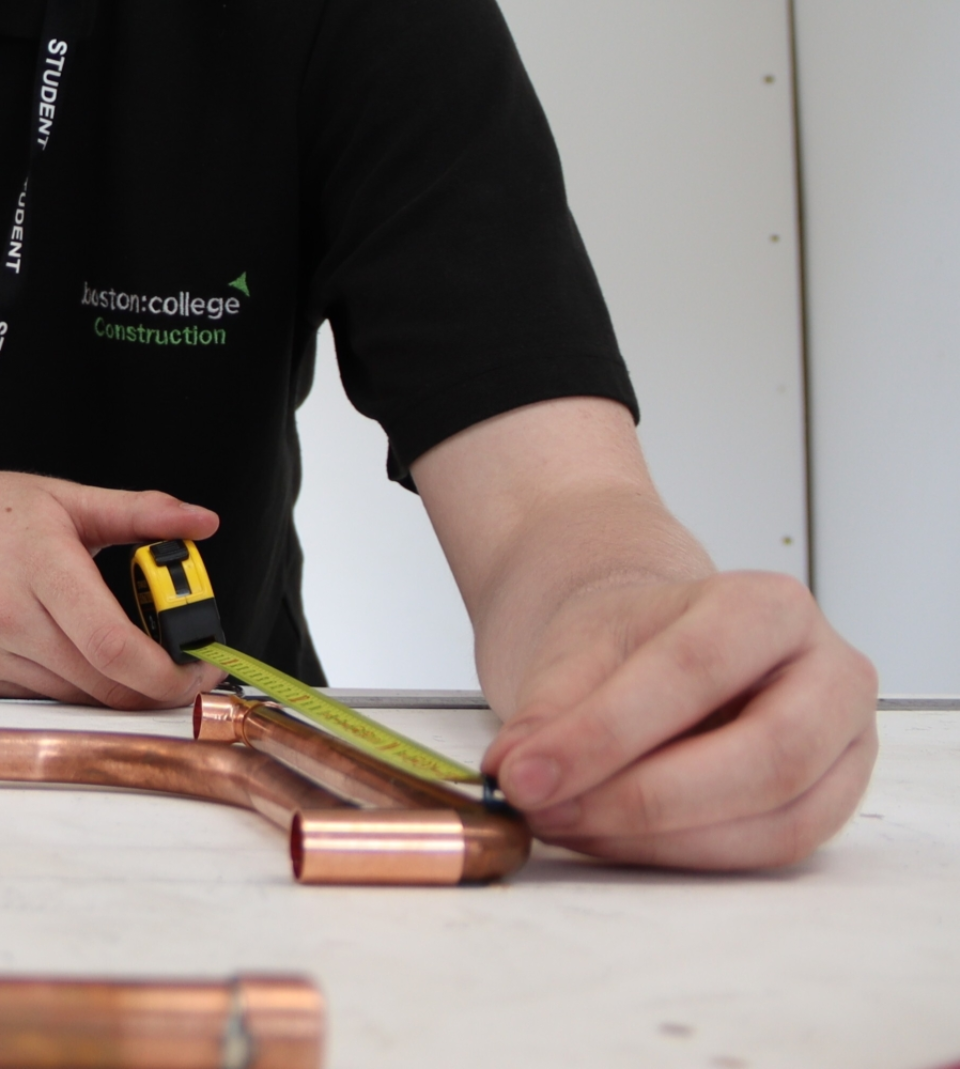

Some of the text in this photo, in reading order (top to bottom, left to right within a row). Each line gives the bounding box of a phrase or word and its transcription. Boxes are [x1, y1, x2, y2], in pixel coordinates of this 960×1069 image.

[37, 39, 68, 151] STUDENT
[5, 177, 28, 274] UDENT
[94, 317, 227, 346] Construction
